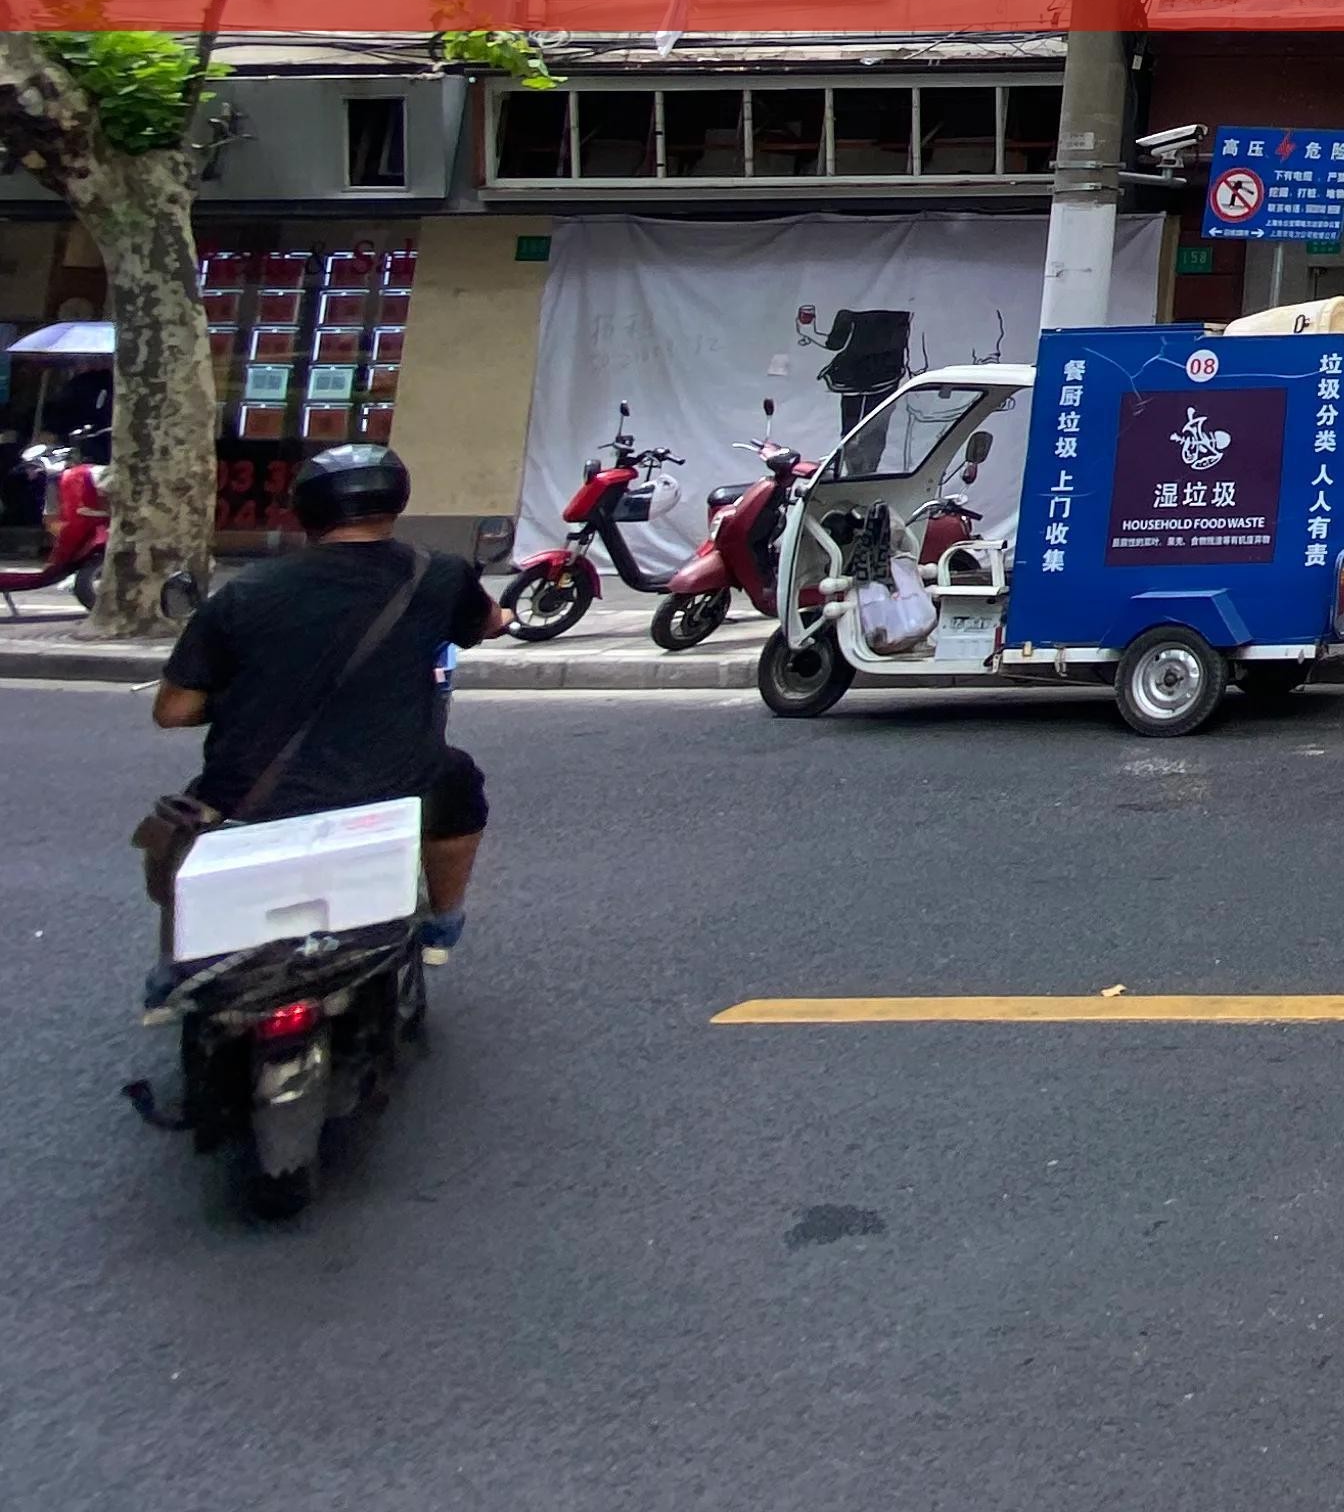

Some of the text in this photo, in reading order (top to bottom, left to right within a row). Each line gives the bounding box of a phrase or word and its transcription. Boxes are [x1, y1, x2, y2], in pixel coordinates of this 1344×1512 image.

[1222, 139, 1265, 157] 高压
[1190, 358, 1215, 375] 08
[1042, 359, 1086, 572] 餐厨垃圾 上门收集
[1304, 353, 1343, 567] 垃圾分类 人人有责
[1153, 481, 1236, 508] 湿垃圾
[1122, 517, 1265, 531] HOUSEHOLD FOOD WASTE
